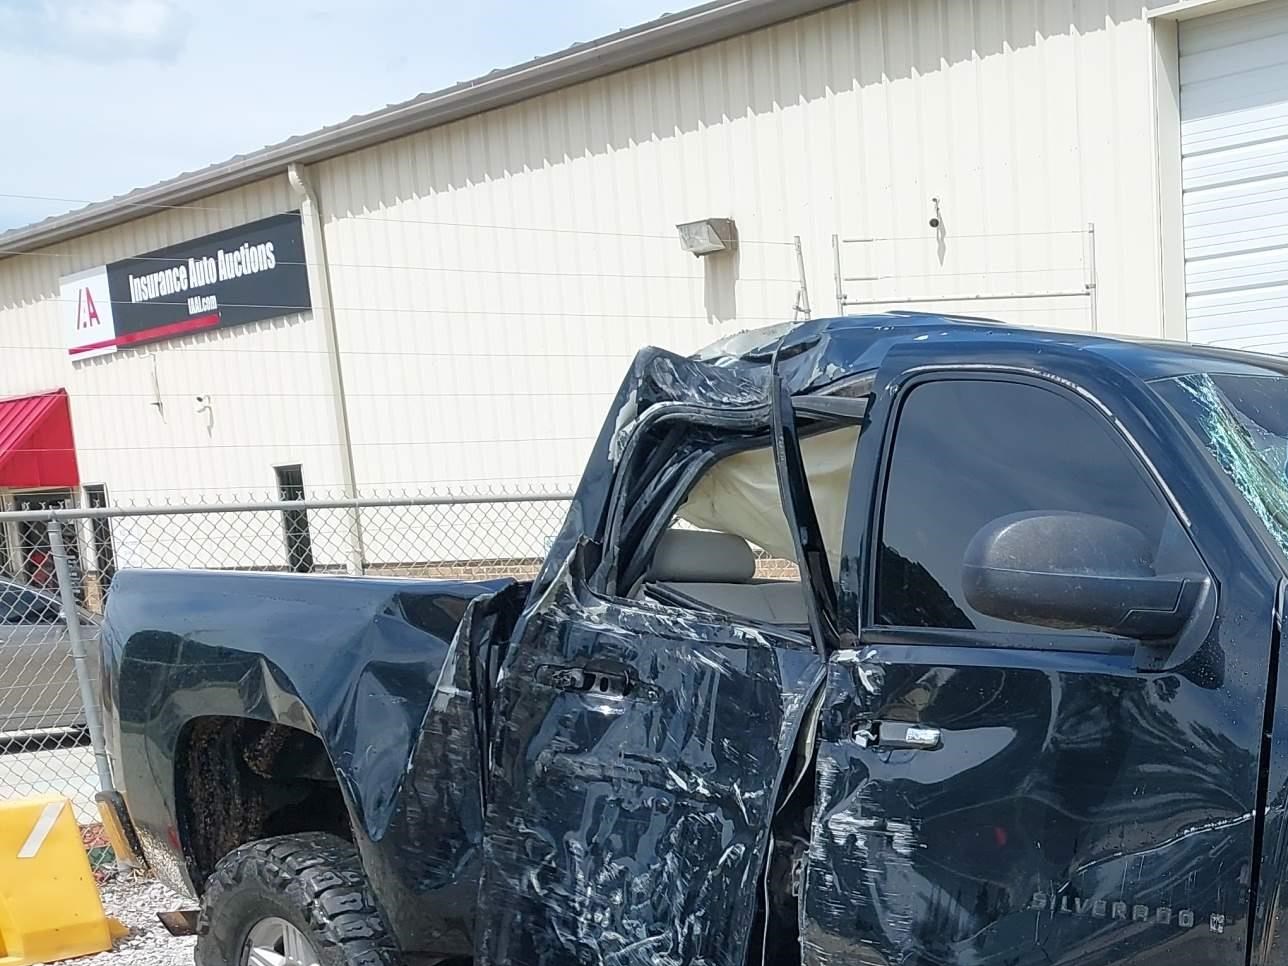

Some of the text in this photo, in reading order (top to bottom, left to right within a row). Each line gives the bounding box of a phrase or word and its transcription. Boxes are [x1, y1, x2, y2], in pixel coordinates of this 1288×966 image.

[129, 241, 276, 304] Insurance Auto Auctions
[1030, 890, 1195, 928] SILVERADO
